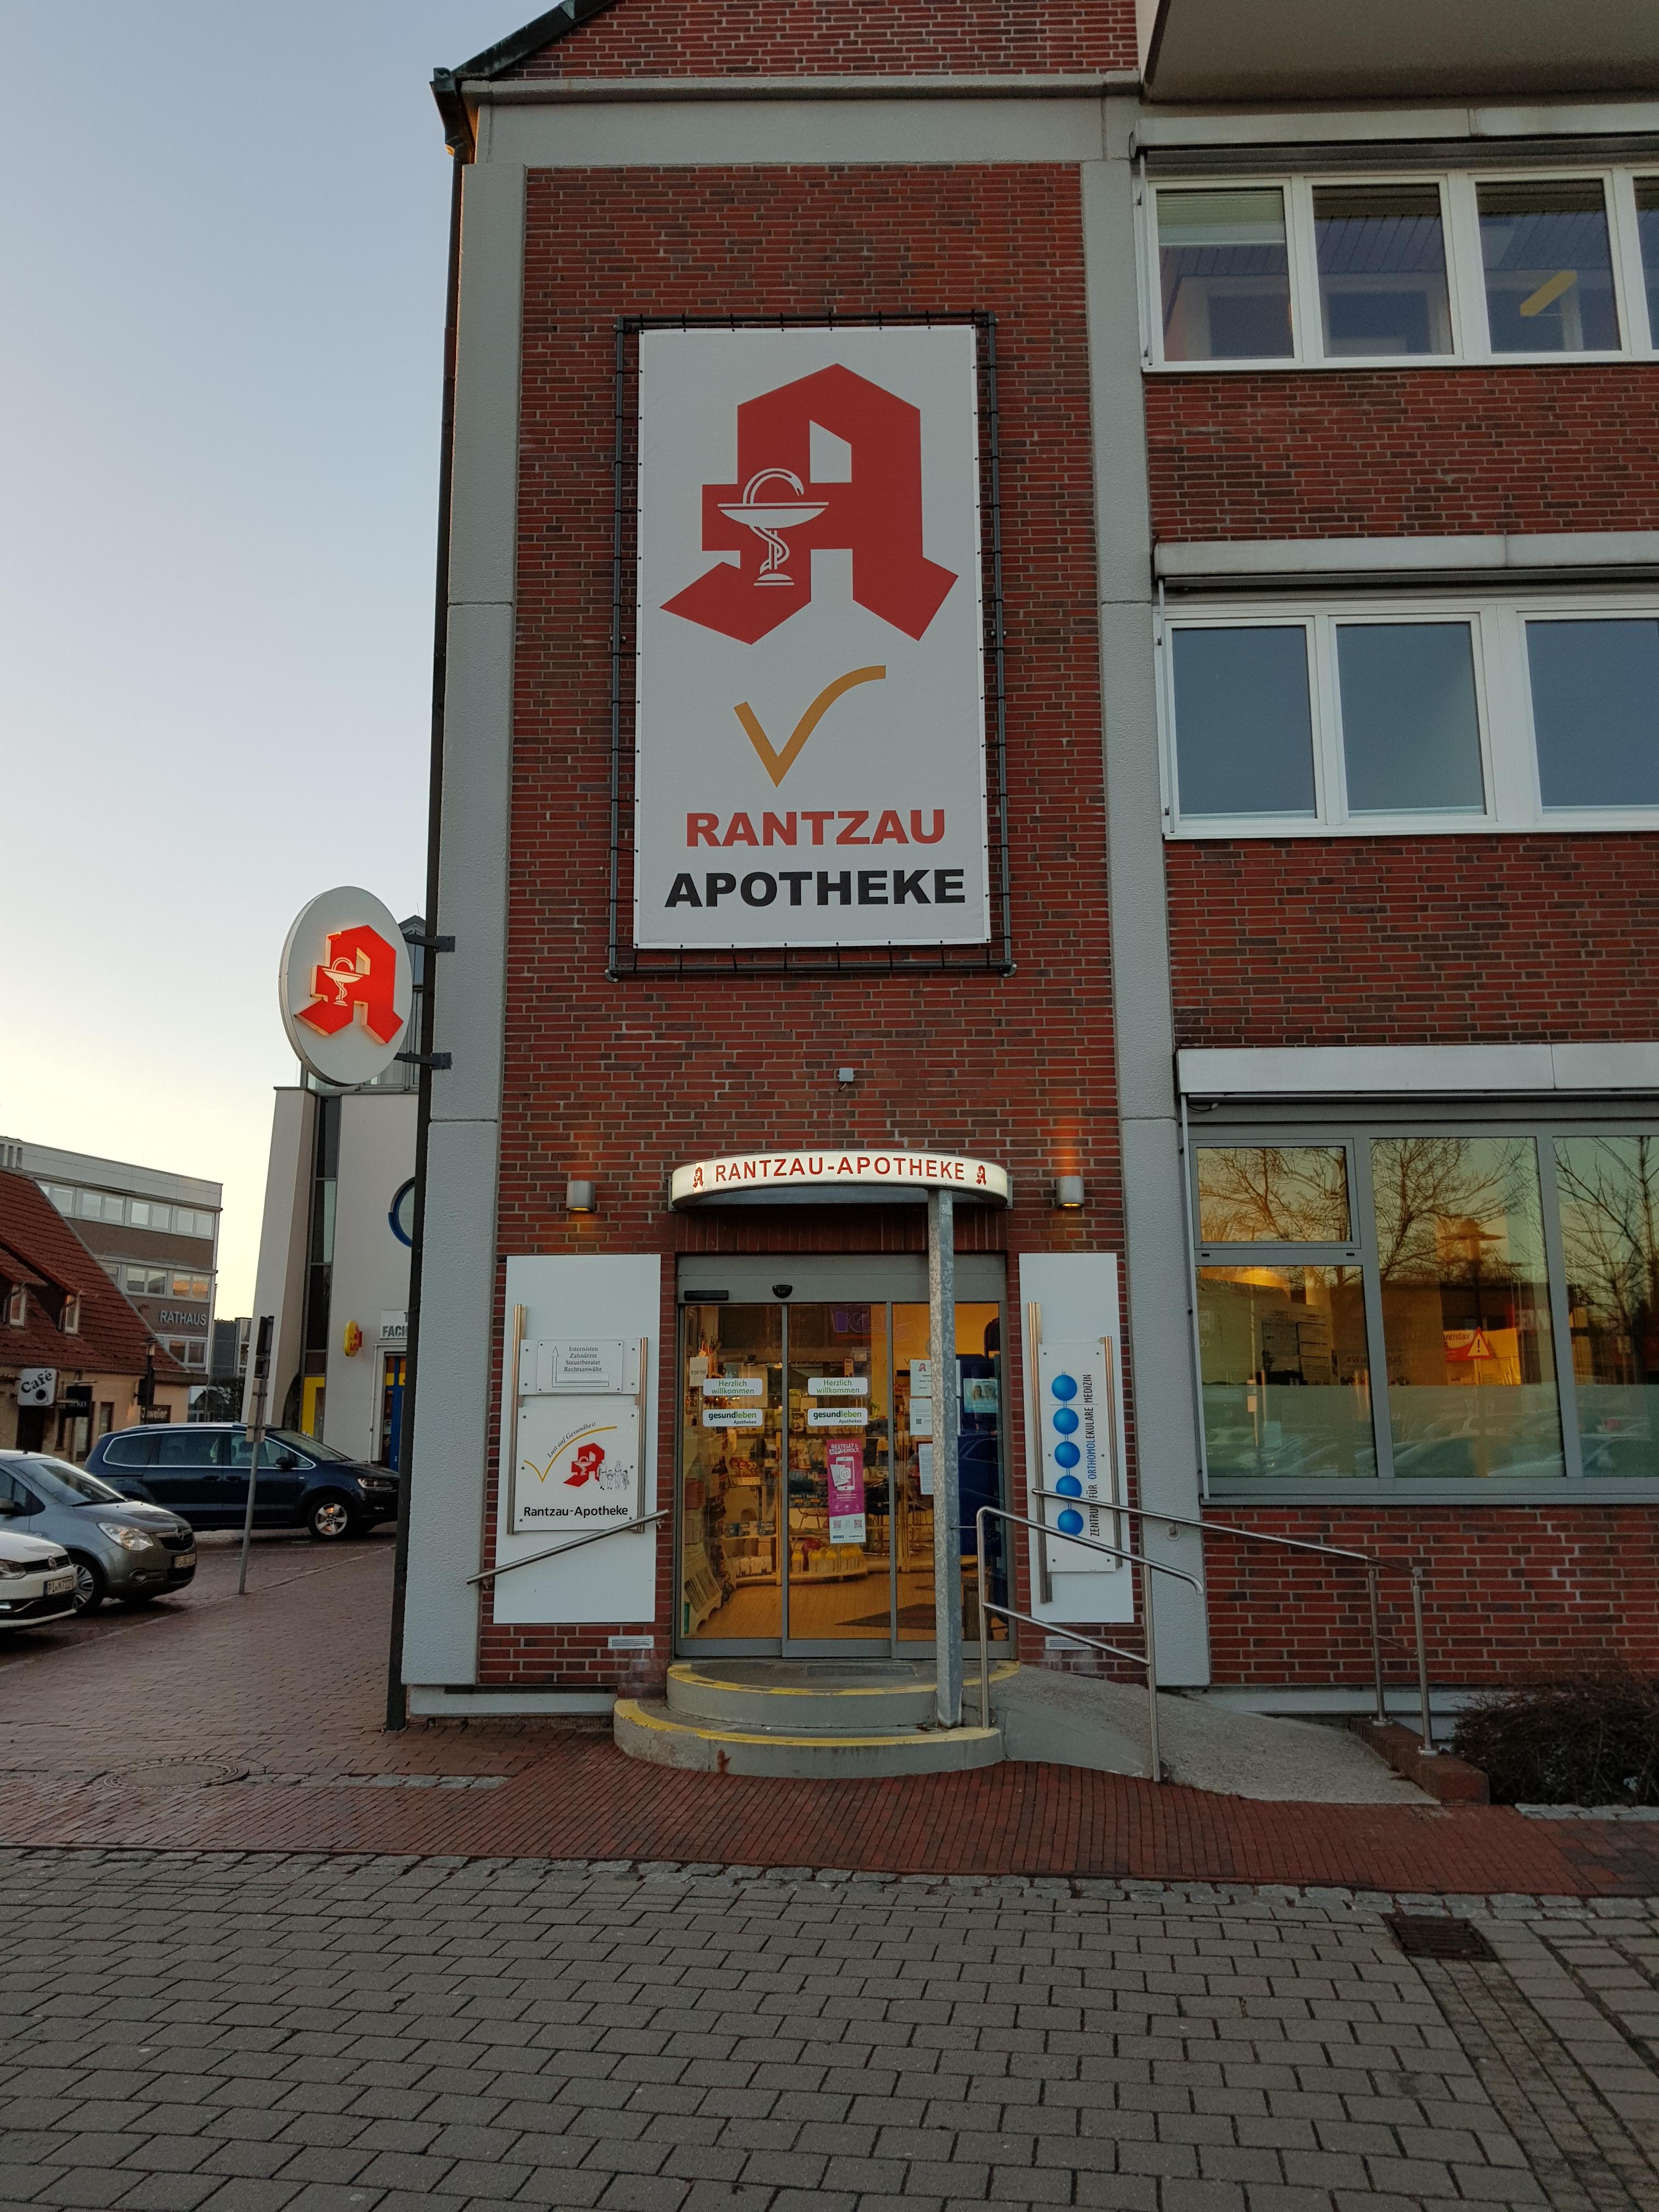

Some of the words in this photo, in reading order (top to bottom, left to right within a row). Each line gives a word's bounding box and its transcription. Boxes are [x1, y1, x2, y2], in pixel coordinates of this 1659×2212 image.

[687, 809, 945, 847] RANTZAU
[664, 869, 965, 907] APOTHEKE
[715, 1156, 965, 1182] RANTZAU-APOTHEKE
[159, 1310, 206, 1325] RATHAUS
[20, 1370, 53, 1394] Café
[1082, 1374, 1093, 1403] MEDIZIN
[708, 1411, 757, 1420] gesundleben
[813, 1410, 862, 1419] gesundleben
[548, 1446, 558, 1458] Lust
[558, 1437, 566, 1447] auf
[566, 1421, 596, 1439] Gesundheit
[1084, 1407, 1097, 1480] ORTHOMOLEKULARE
[1086, 1485, 1098, 1498] FÜR
[523, 1505, 628, 1518] Rantzau-Apotheke
